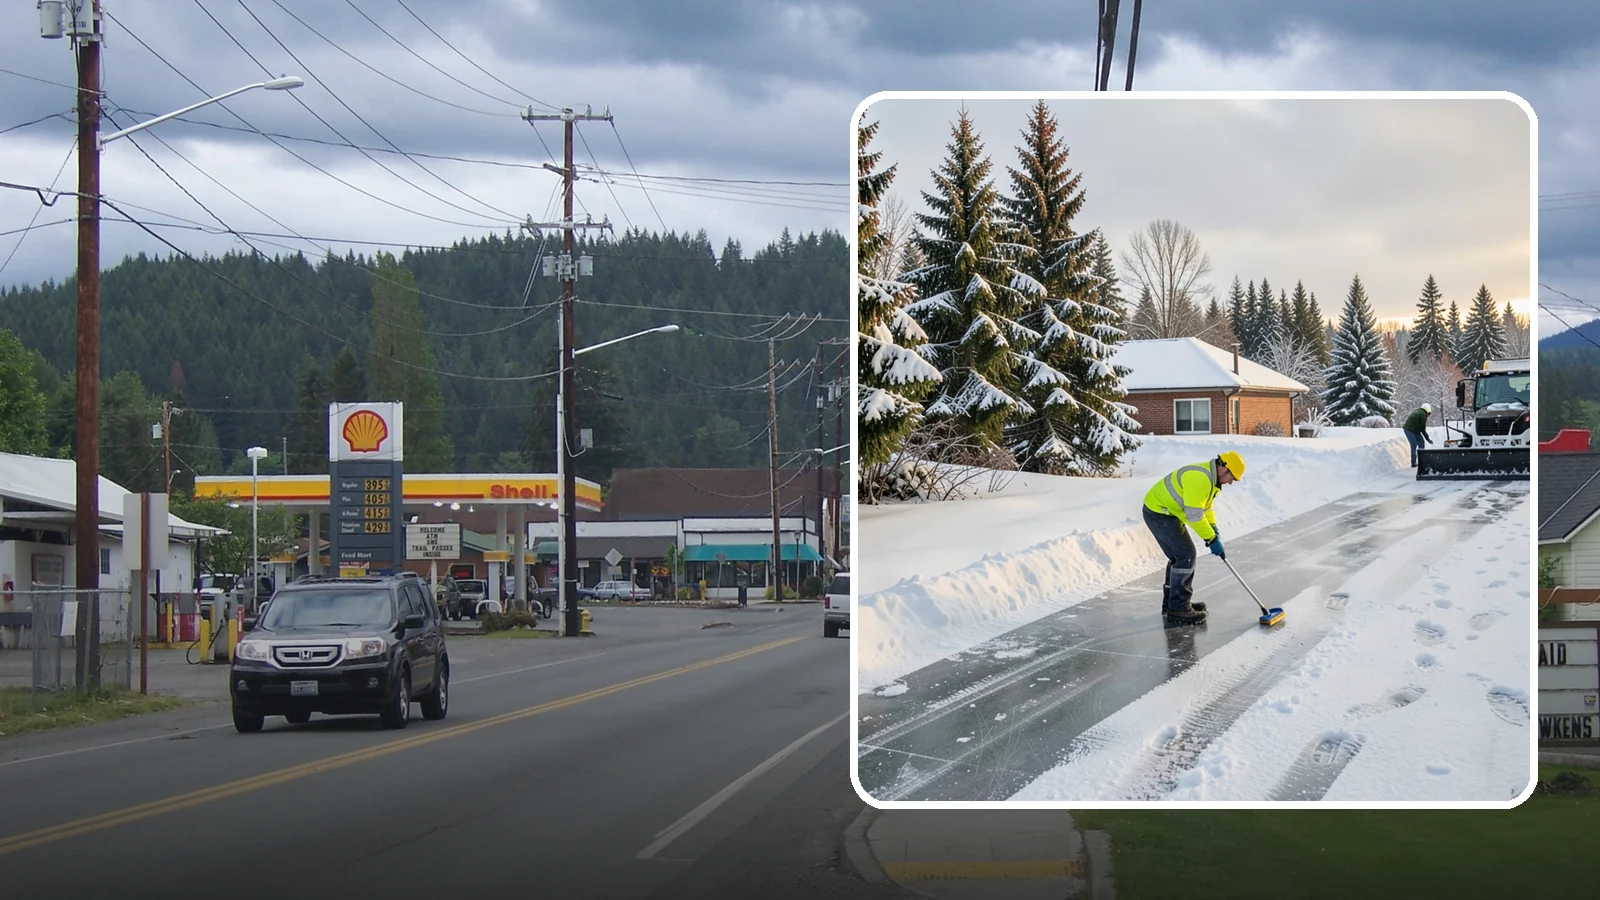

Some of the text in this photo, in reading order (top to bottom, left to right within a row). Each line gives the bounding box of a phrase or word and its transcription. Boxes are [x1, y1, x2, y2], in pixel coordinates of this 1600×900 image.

[365, 480, 383, 490] 395
[490, 484, 547, 499] Shell
[365, 494, 383, 504] 405
[365, 508, 383, 518] 415
[365, 522, 383, 532] 429
